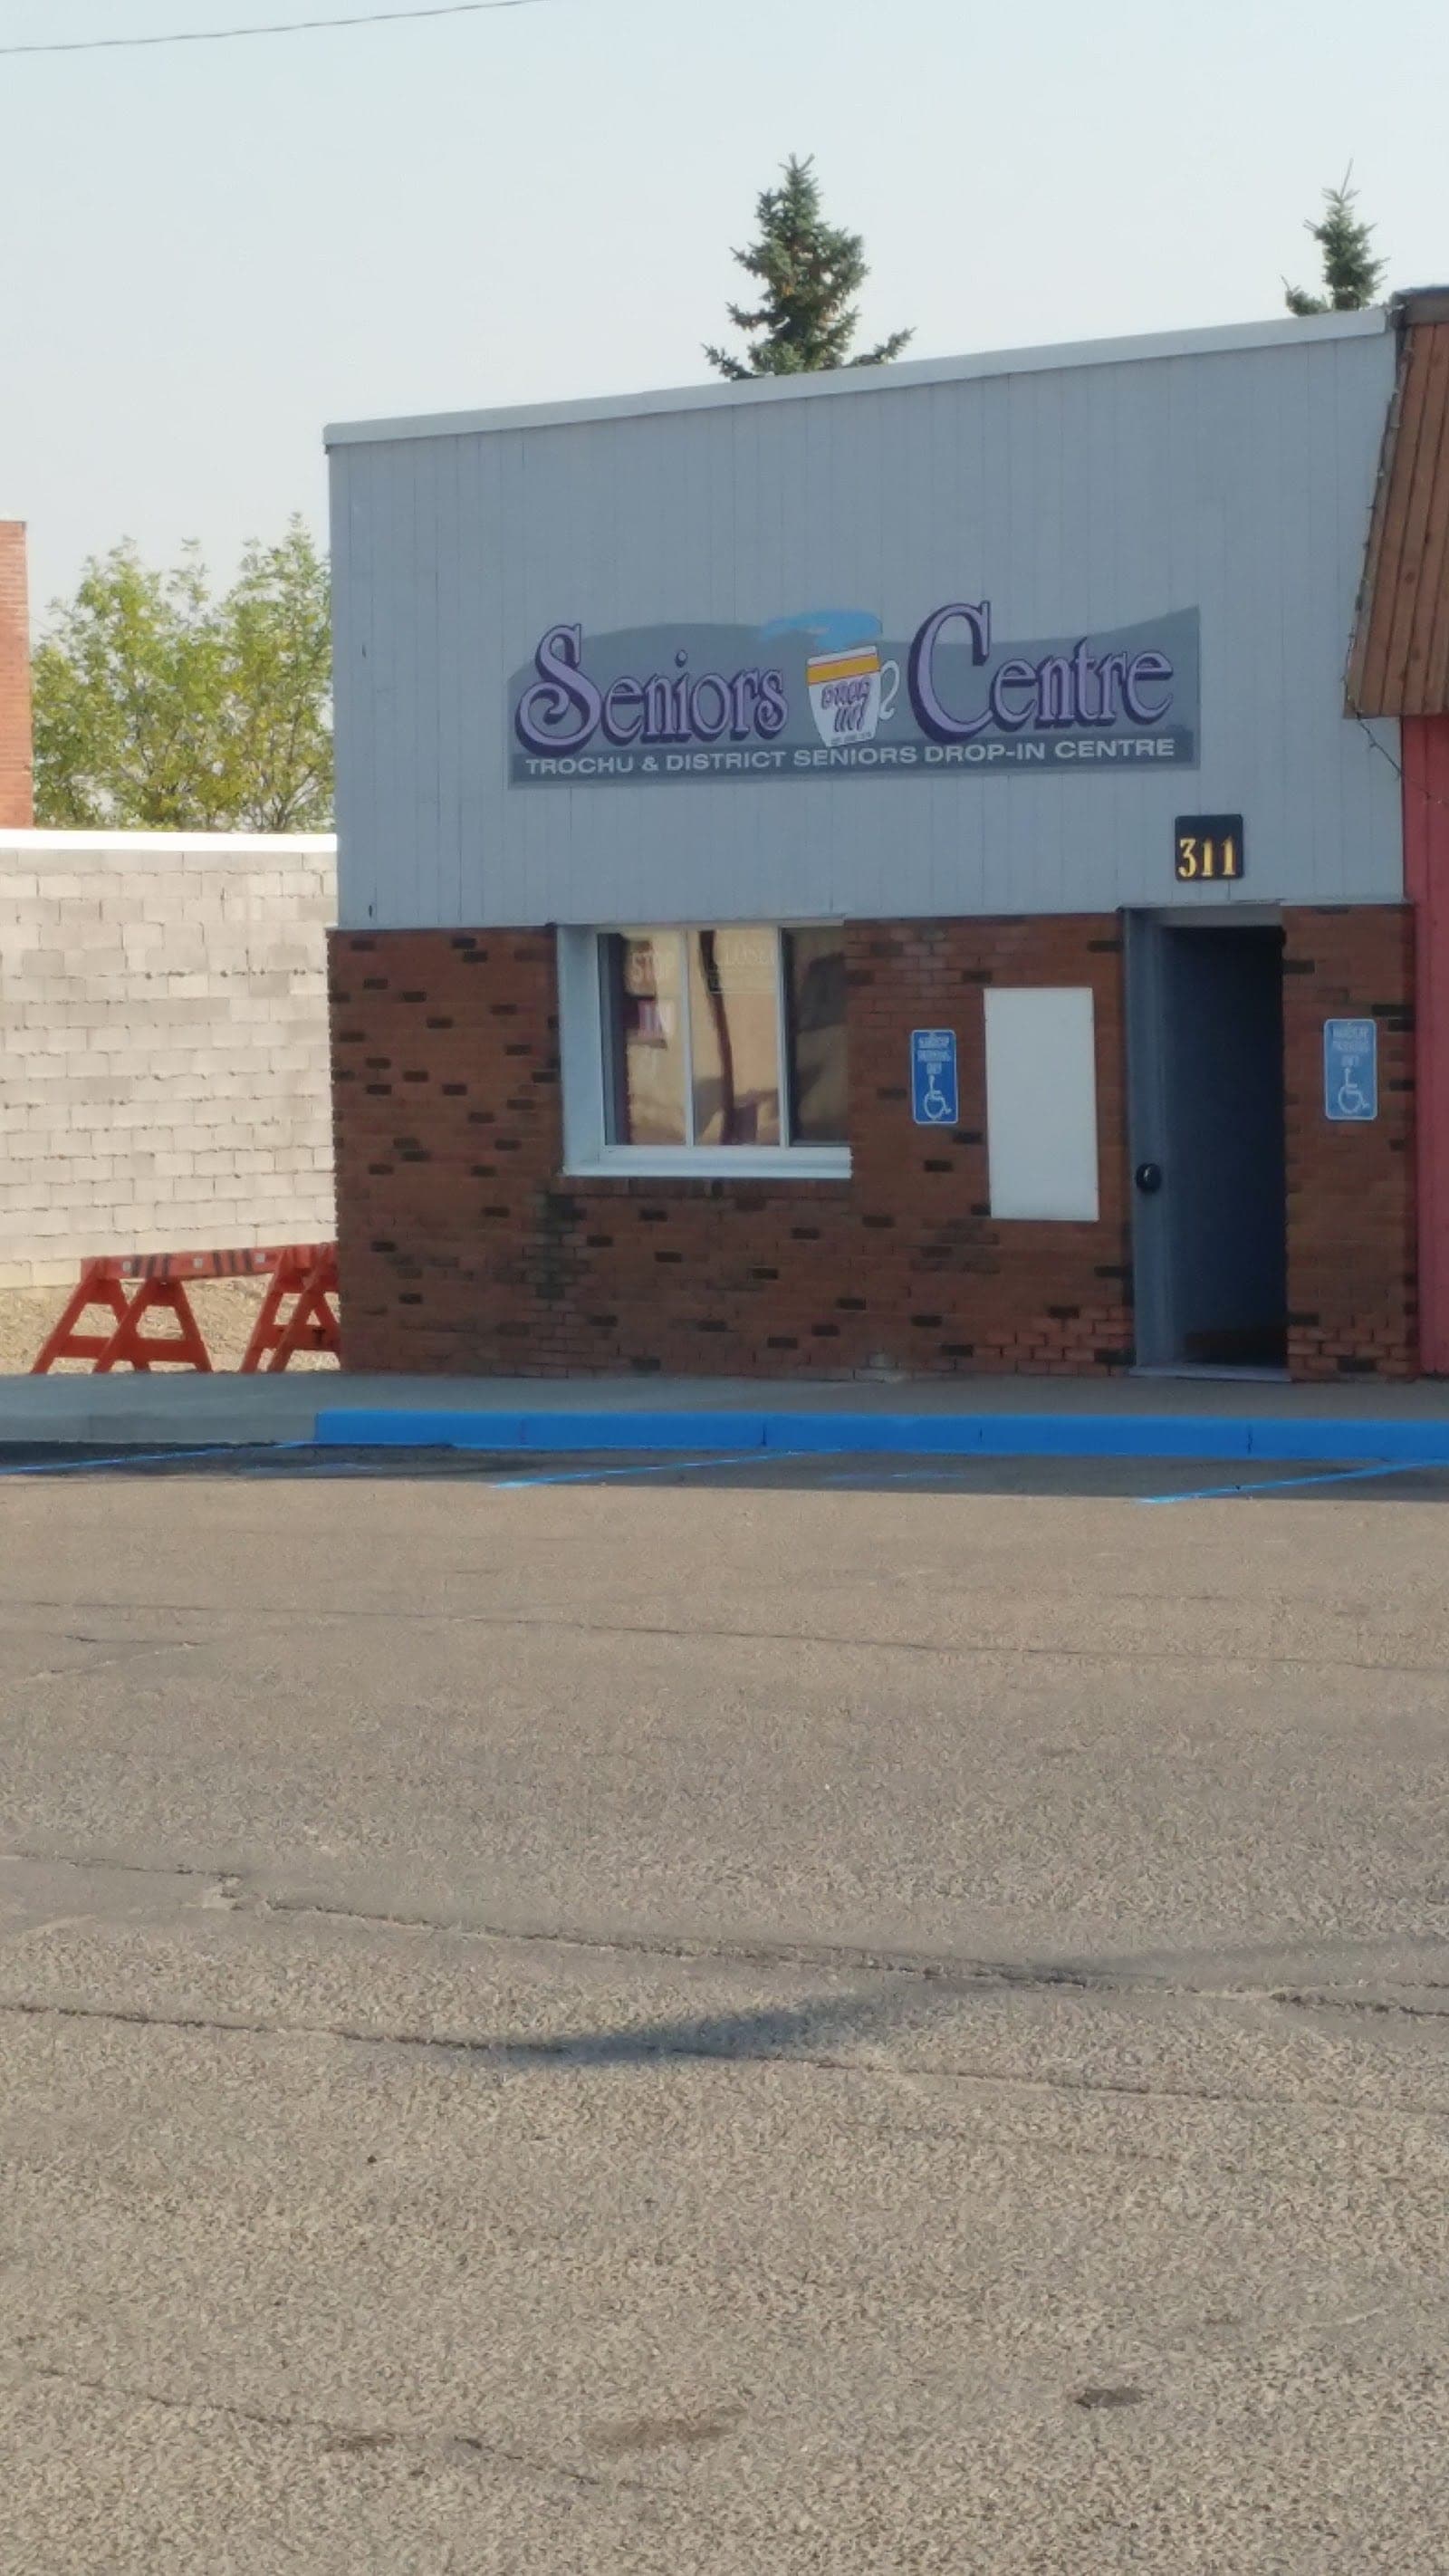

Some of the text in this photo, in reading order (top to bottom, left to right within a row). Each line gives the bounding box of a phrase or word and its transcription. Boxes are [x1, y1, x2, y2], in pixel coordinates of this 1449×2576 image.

[514, 601, 1174, 757] Seniors Centre
[525, 738, 1175, 775] TROCHU & DISTRICT SENIORS DROP-IN CENTRE
[1178, 836, 1236, 878] 311
